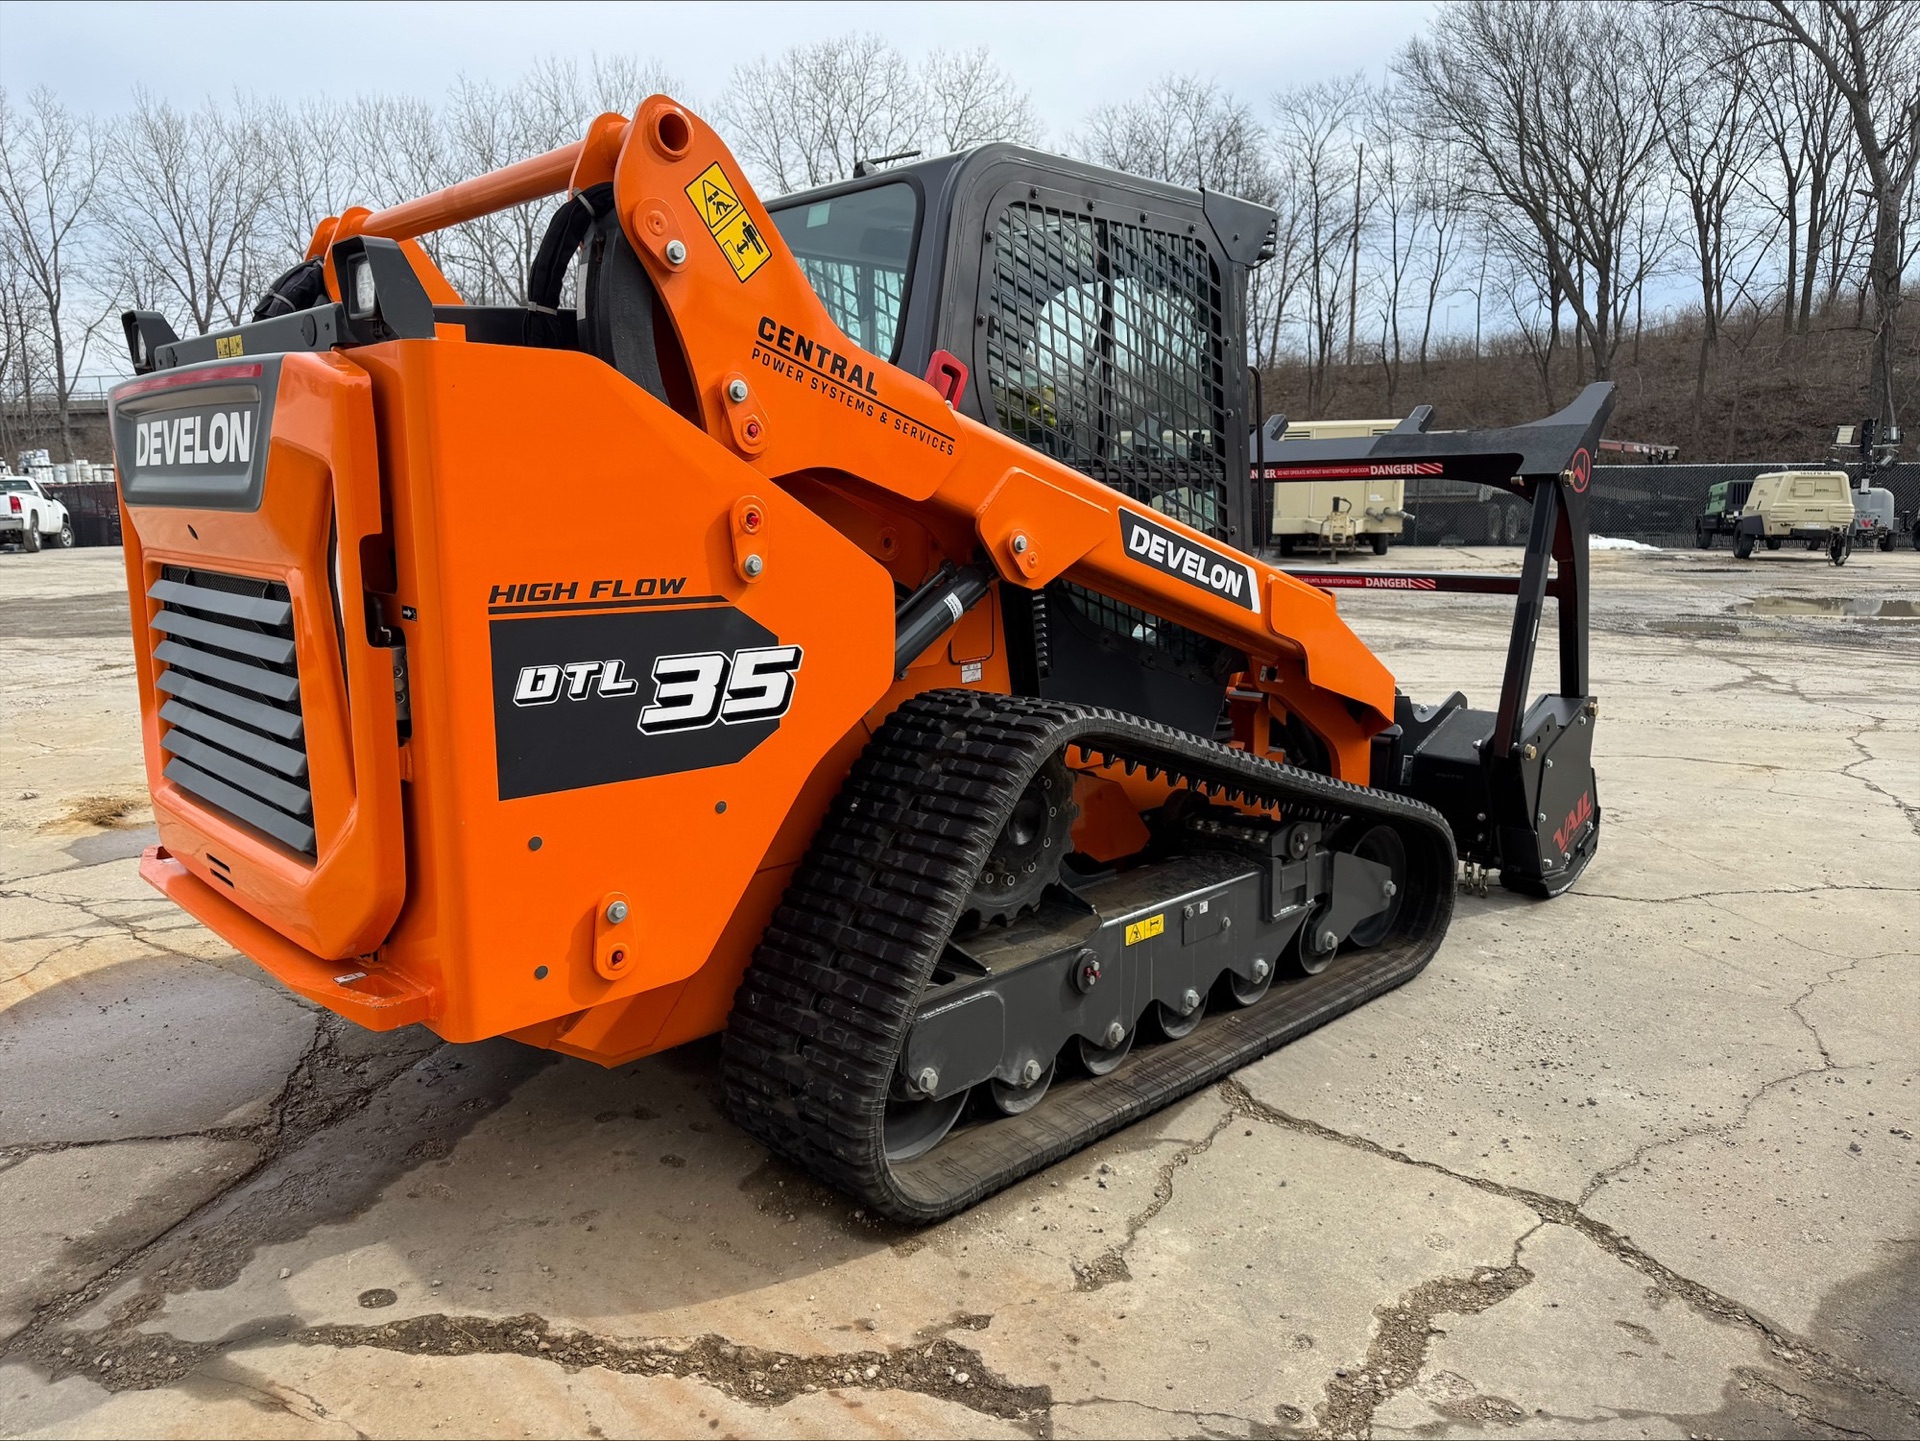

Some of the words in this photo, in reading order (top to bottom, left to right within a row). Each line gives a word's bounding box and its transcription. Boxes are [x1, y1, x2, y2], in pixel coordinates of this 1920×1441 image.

[758, 316, 878, 396] CENTRAL
[751, 347, 804, 384] POWER
[810, 377, 874, 417] SYSTEMS
[879, 411, 888, 424] &
[894, 418, 954, 456] SERVICES
[135, 410, 251, 467] DEVELON
[1370, 464, 1413, 475] DANGER
[488, 581, 579, 604] HIGH
[589, 577, 687, 598] FLOW
[1129, 524, 1243, 598] DEVELON
[1365, 577, 1406, 588] DANGER
[513, 659, 639, 707] DTL
[636, 644, 804, 736] 35
[1552, 789, 1592, 854] VAIL
